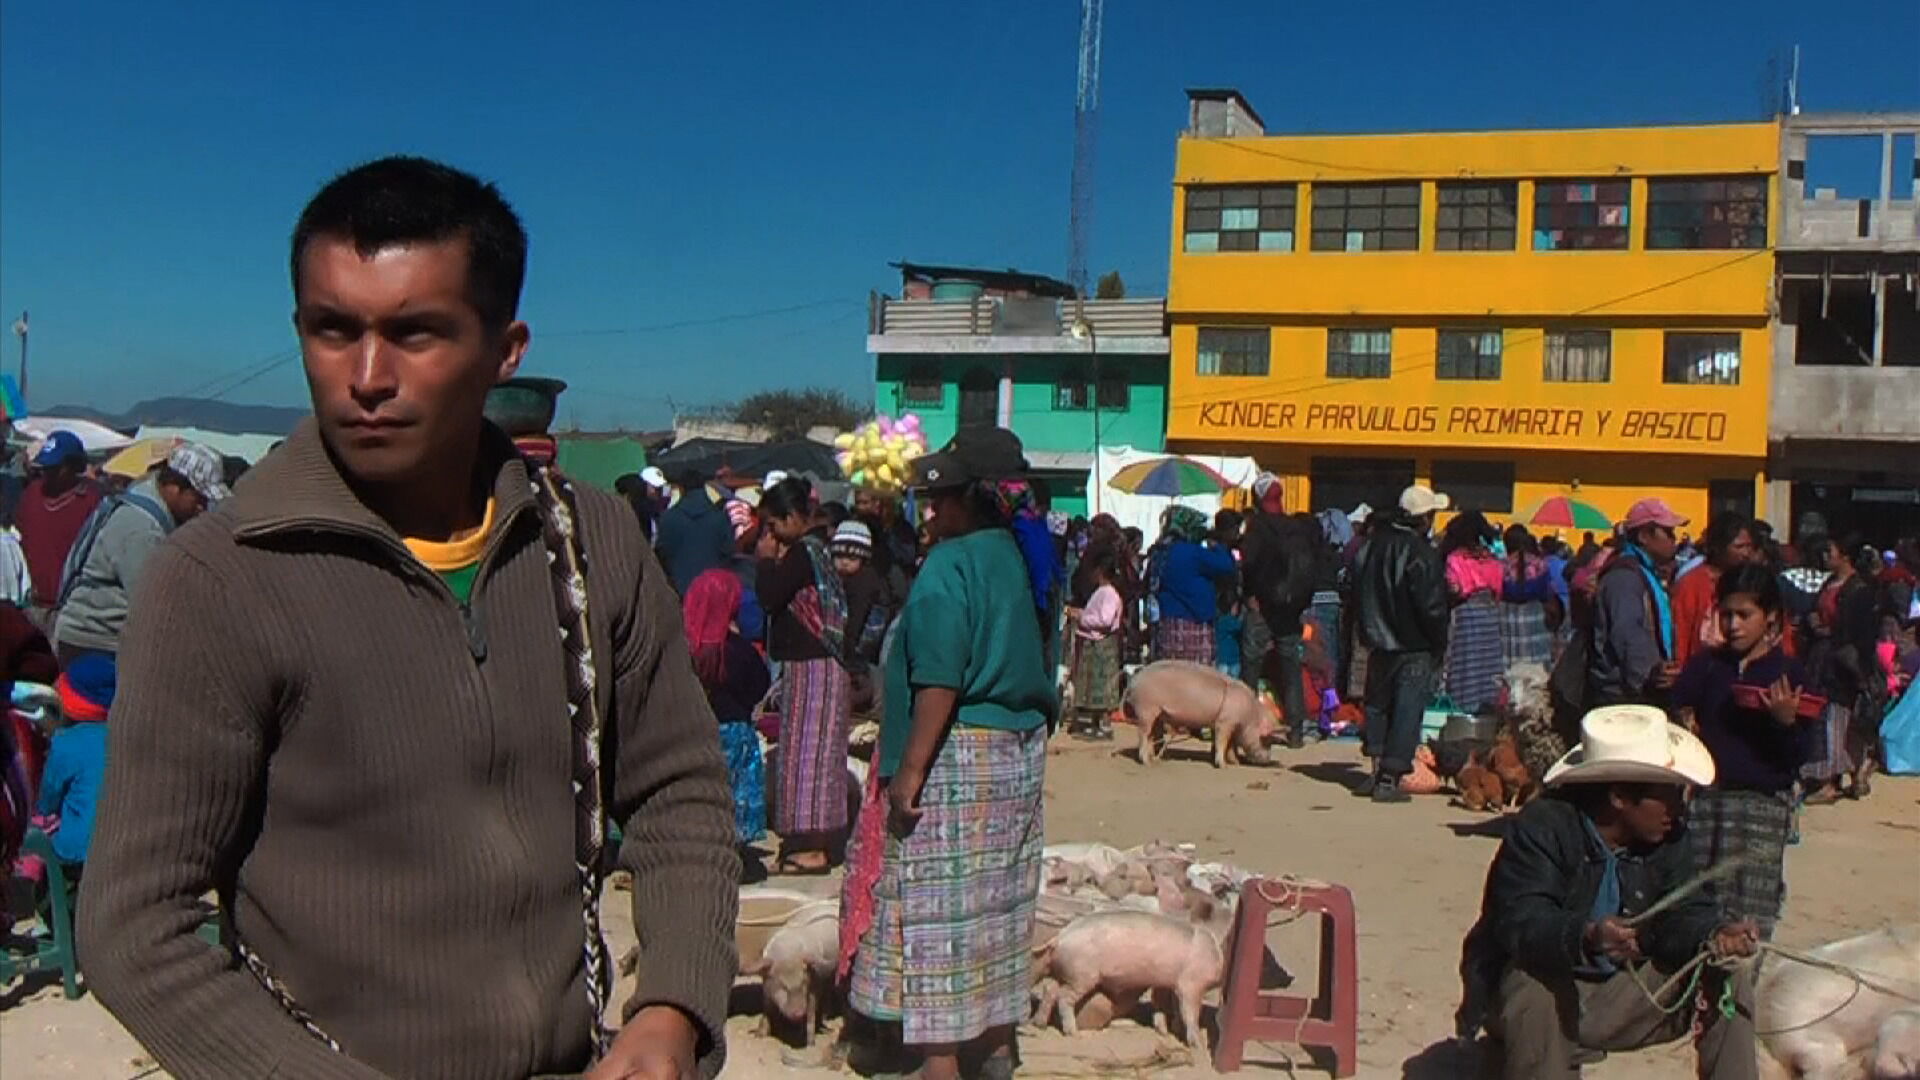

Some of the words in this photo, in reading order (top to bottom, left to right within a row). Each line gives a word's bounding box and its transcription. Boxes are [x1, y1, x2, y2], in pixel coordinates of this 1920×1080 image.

[1199, 401, 1296, 428] KINDER
[1306, 404, 1438, 432] PARVULOS
[1447, 406, 1583, 436] PRIMARIA
[1596, 410, 1612, 436] Y
[1620, 410, 1727, 441] BASICO
